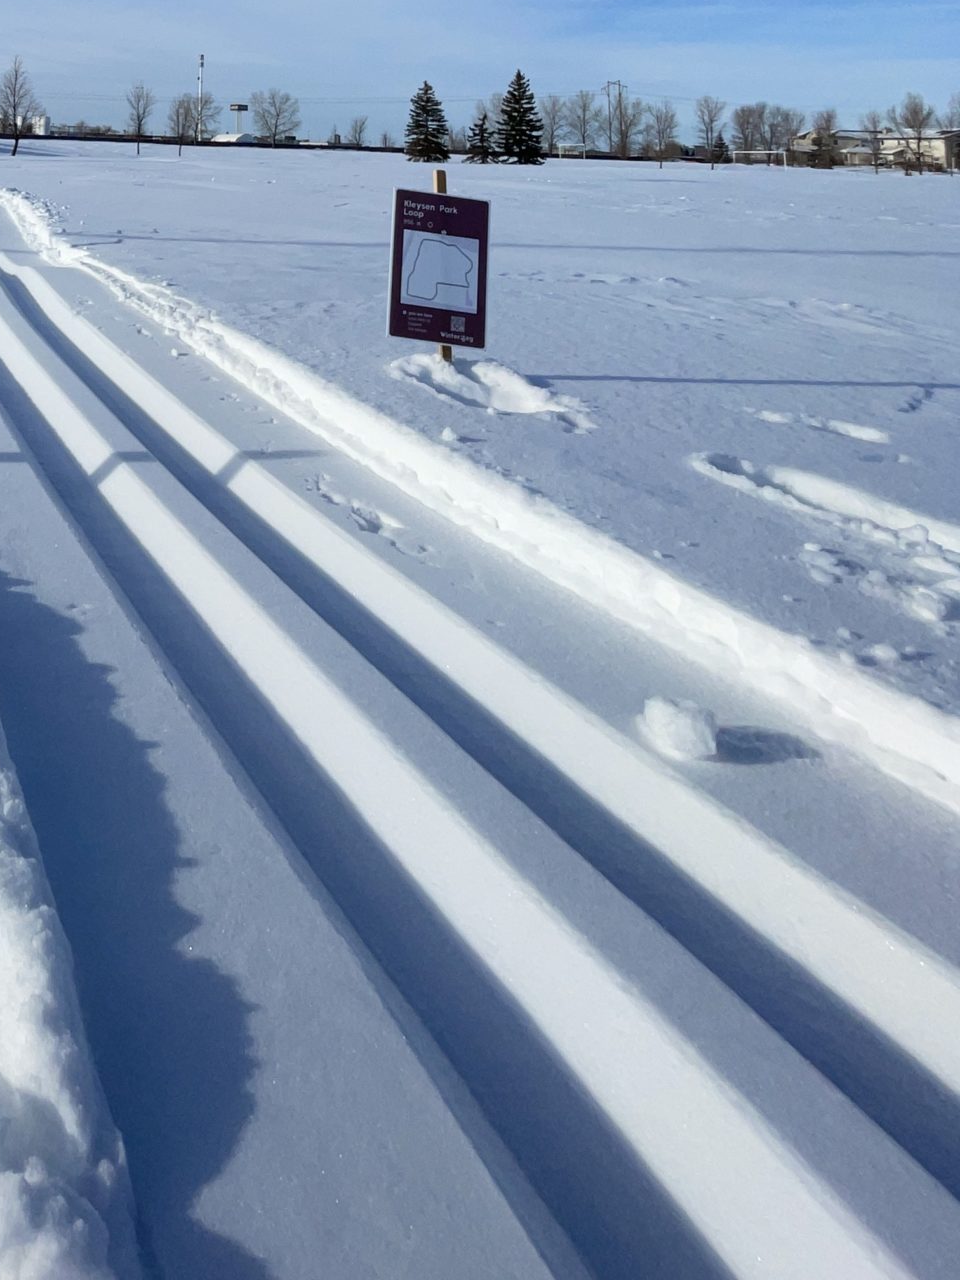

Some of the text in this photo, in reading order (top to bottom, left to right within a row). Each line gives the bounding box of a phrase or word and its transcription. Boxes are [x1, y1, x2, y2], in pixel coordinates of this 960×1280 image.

[403, 200, 458, 214] Kleysen Park
[403, 208, 424, 218] Loop
